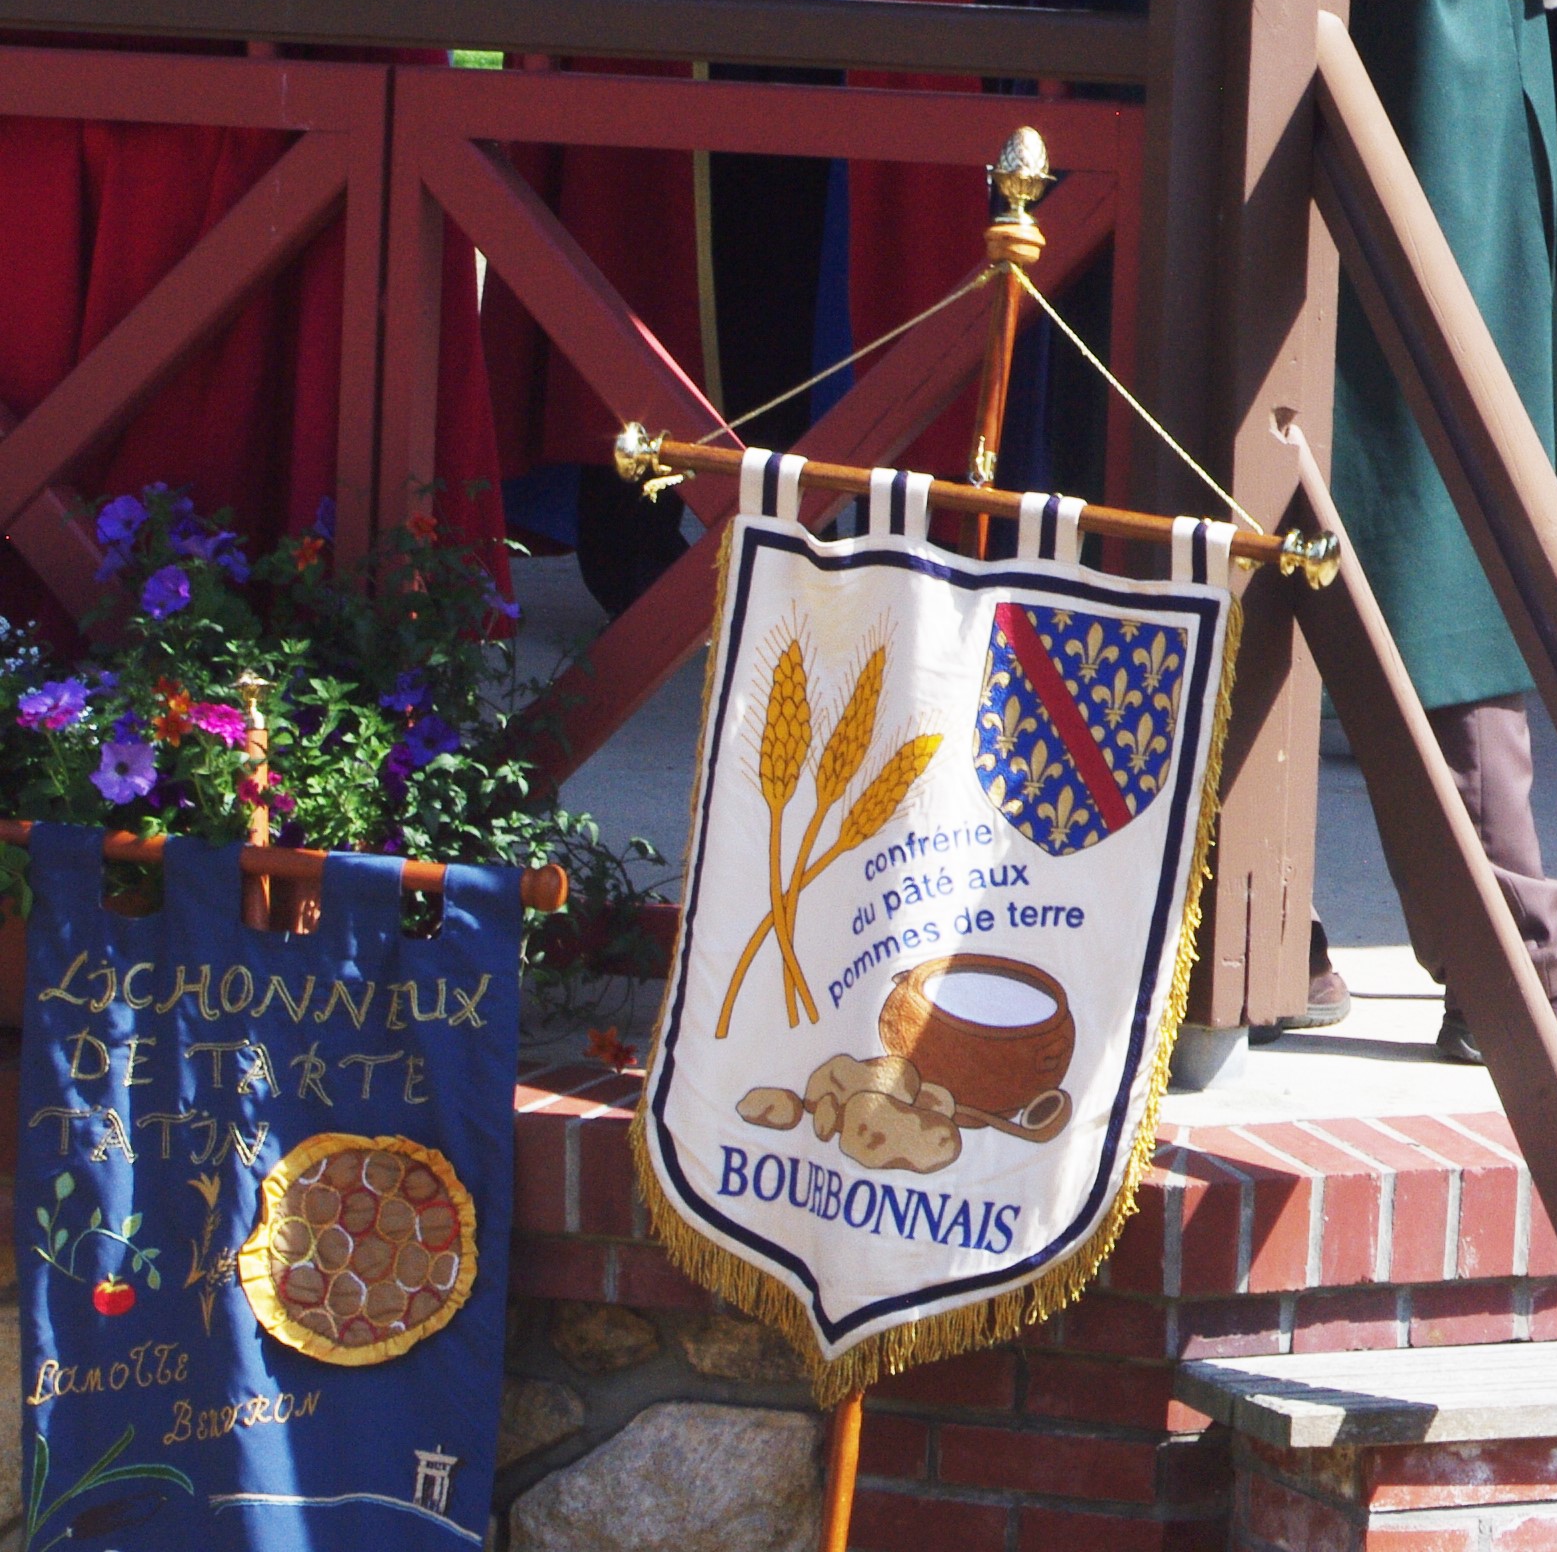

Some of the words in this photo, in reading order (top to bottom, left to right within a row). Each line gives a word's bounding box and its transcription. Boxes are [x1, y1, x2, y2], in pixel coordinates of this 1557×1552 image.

[864, 822, 994, 881] confrérie
[852, 903, 876, 935] du
[882, 866, 954, 920] pâté
[967, 863, 1030, 889] aux
[827, 920, 941, 1009] pommes
[953, 907, 995, 935] de
[1007, 901, 1085, 928] terre
[66, 1027, 156, 1086] DE
[184, 1038, 430, 1106] TARTE
[716, 1144, 1021, 1254] BOURBONNAIS
